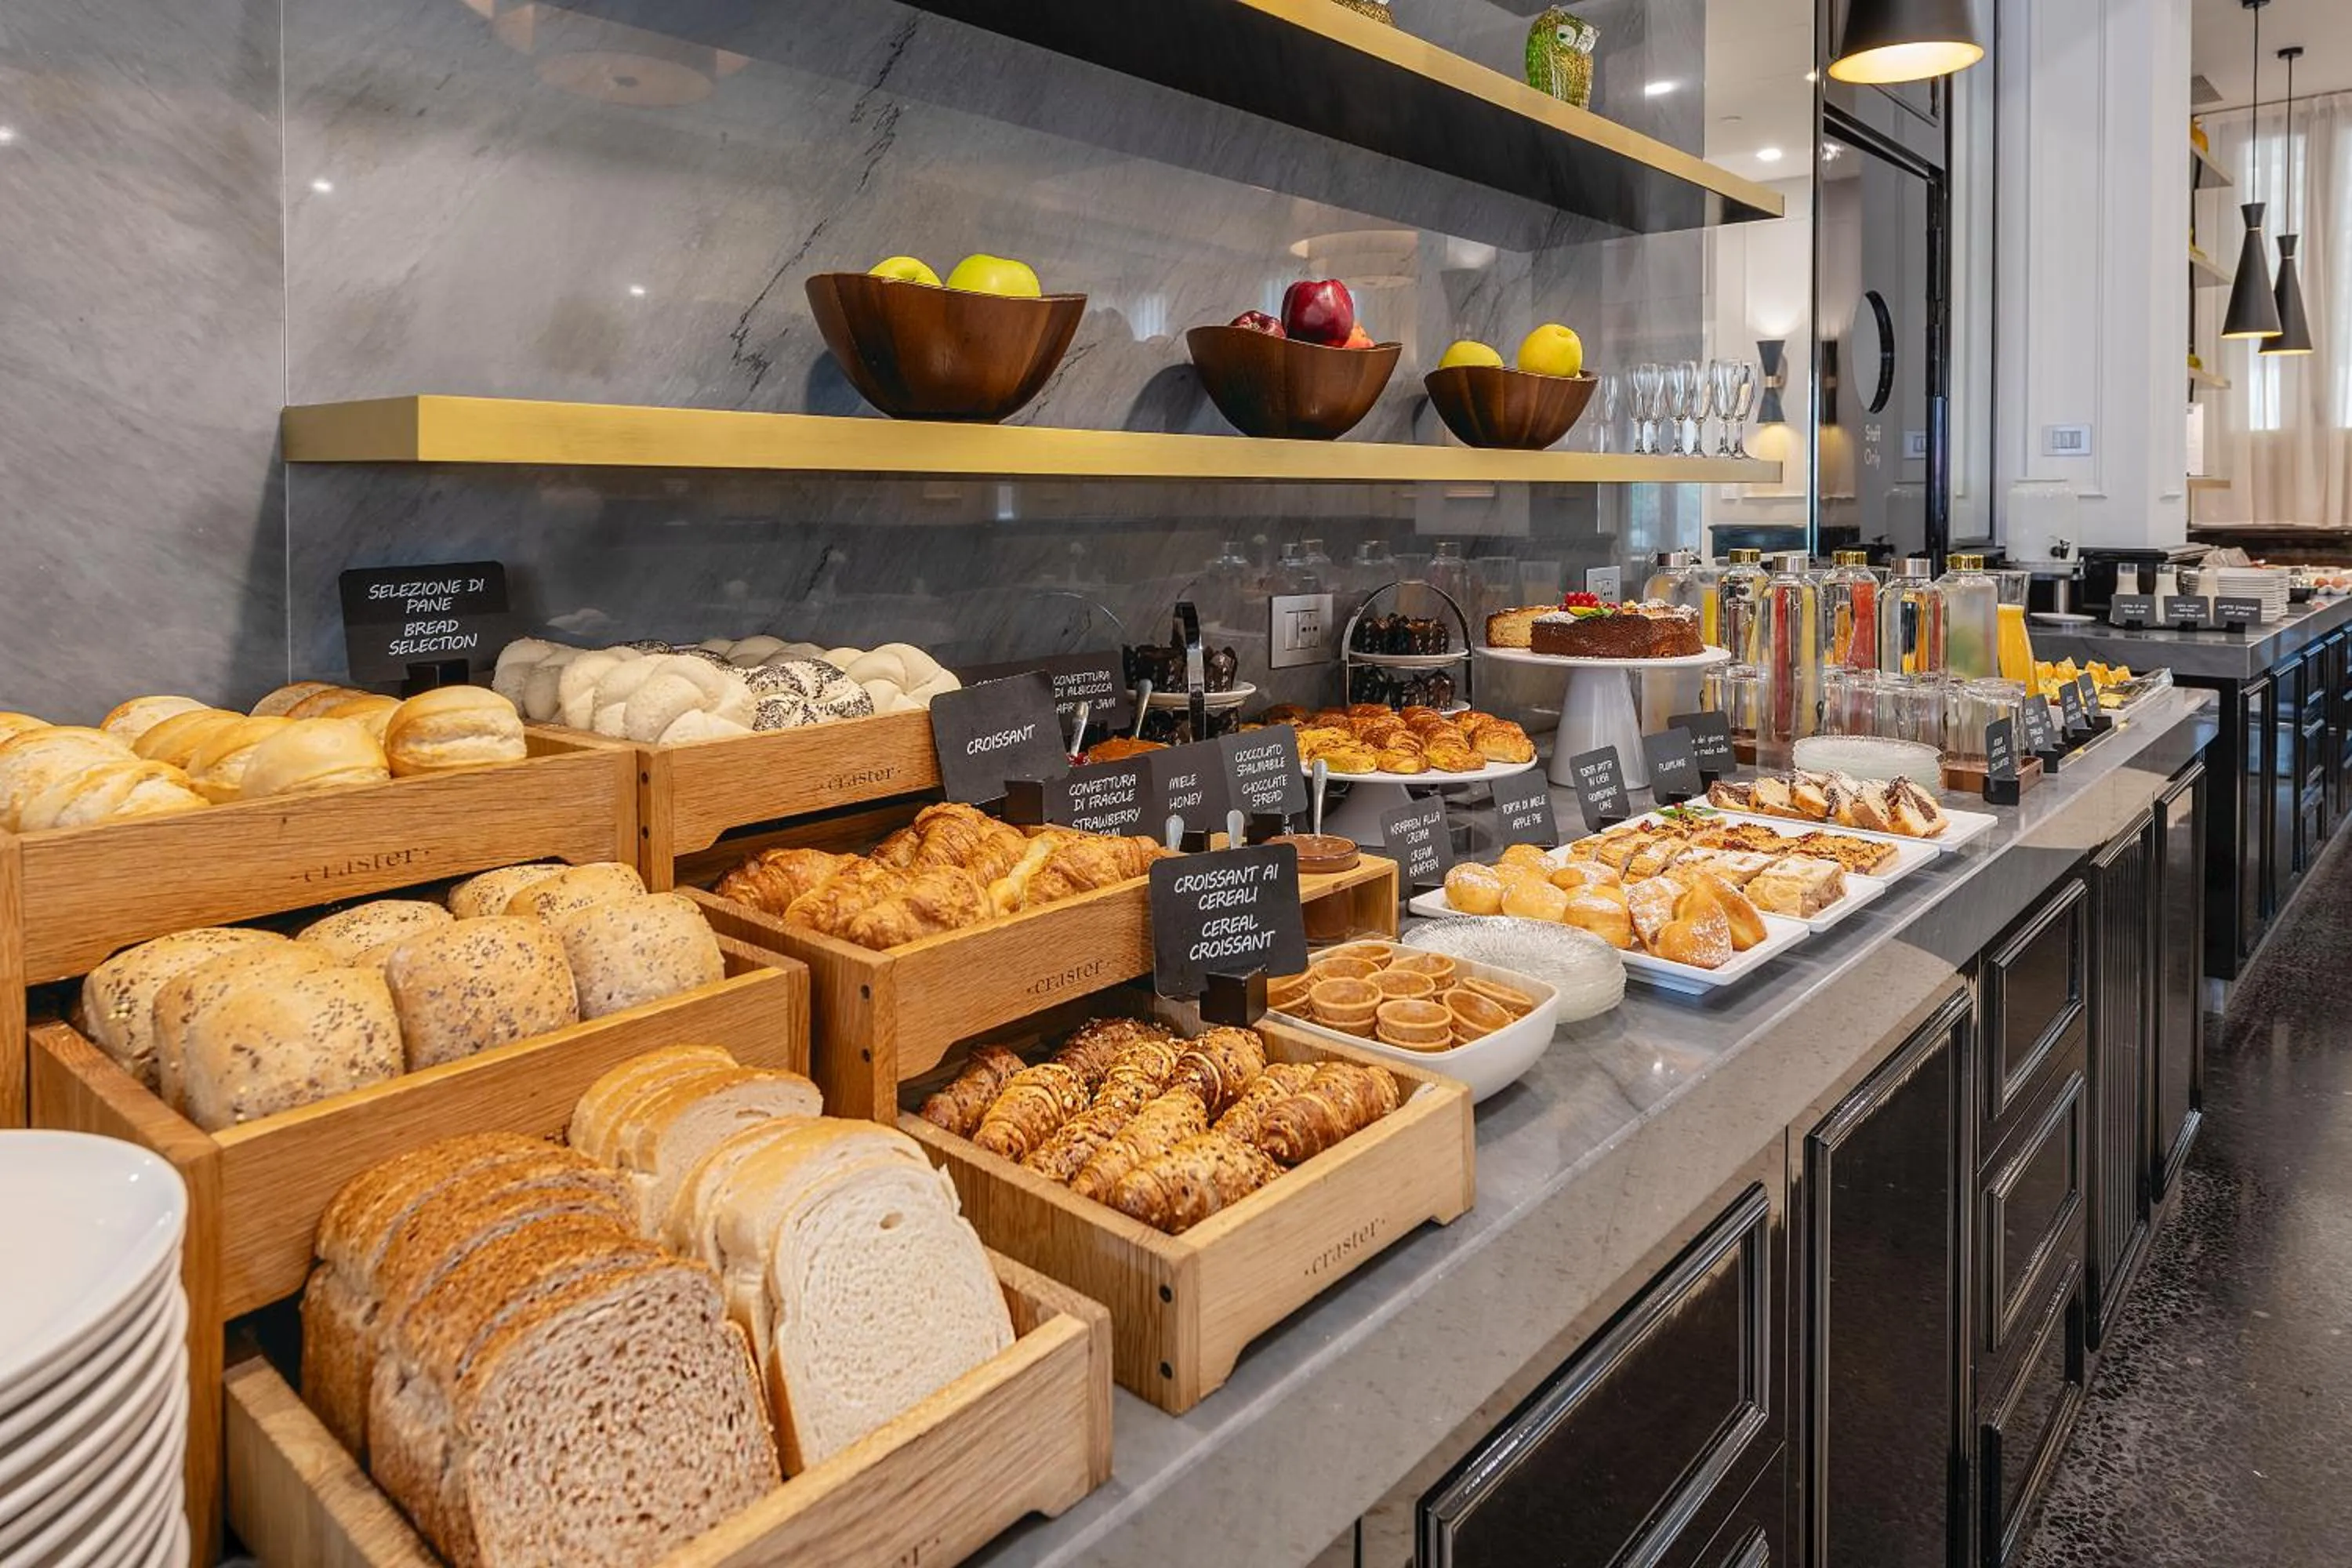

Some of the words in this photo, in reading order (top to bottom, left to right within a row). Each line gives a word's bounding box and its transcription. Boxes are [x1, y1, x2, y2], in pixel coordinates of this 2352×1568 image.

[368, 579, 462, 600] SELEZIONE
[467, 578, 485, 593] DI
[405, 597, 453, 614] PANE
[404, 619, 459, 637] BREAD
[388, 633, 477, 655] SELECTION
[1053, 670, 1110, 686] CONFETTURA
[1054, 687, 1065, 699] DI
[1067, 682, 1112, 697] ALBICOCCA
[1056, 700, 1094, 715] APRT
[1095, 698, 1116, 710] JAM
[967, 724, 1036, 756] CROISSANT
[1235, 743, 1283, 763] CIOCCOLATO
[1236, 756, 1287, 778] SPALMABILE
[1069, 774, 1137, 797] CONFETTURA
[1168, 774, 1198, 790] MIELE
[1241, 774, 1288, 795] CHOCOLATE
[1073, 798, 1084, 812] DI
[1089, 788, 1135, 810] FRAGOLE
[1169, 790, 1203, 811] HONEY
[1252, 789, 1283, 807] SPREAD
[1072, 807, 1142, 831] STRAWBERRY
[1423, 811, 1440, 826] ALLA
[1406, 828, 1429, 844] CREMA
[1409, 855, 1439, 877] KRAPFEN
[1174, 865, 1259, 893] CROISSANT
[1263, 863, 1279, 881] AI
[1199, 887, 1258, 910] CEREALI
[1202, 913, 1258, 937] CEREAL
[1189, 930, 1276, 961] CROISSANT
